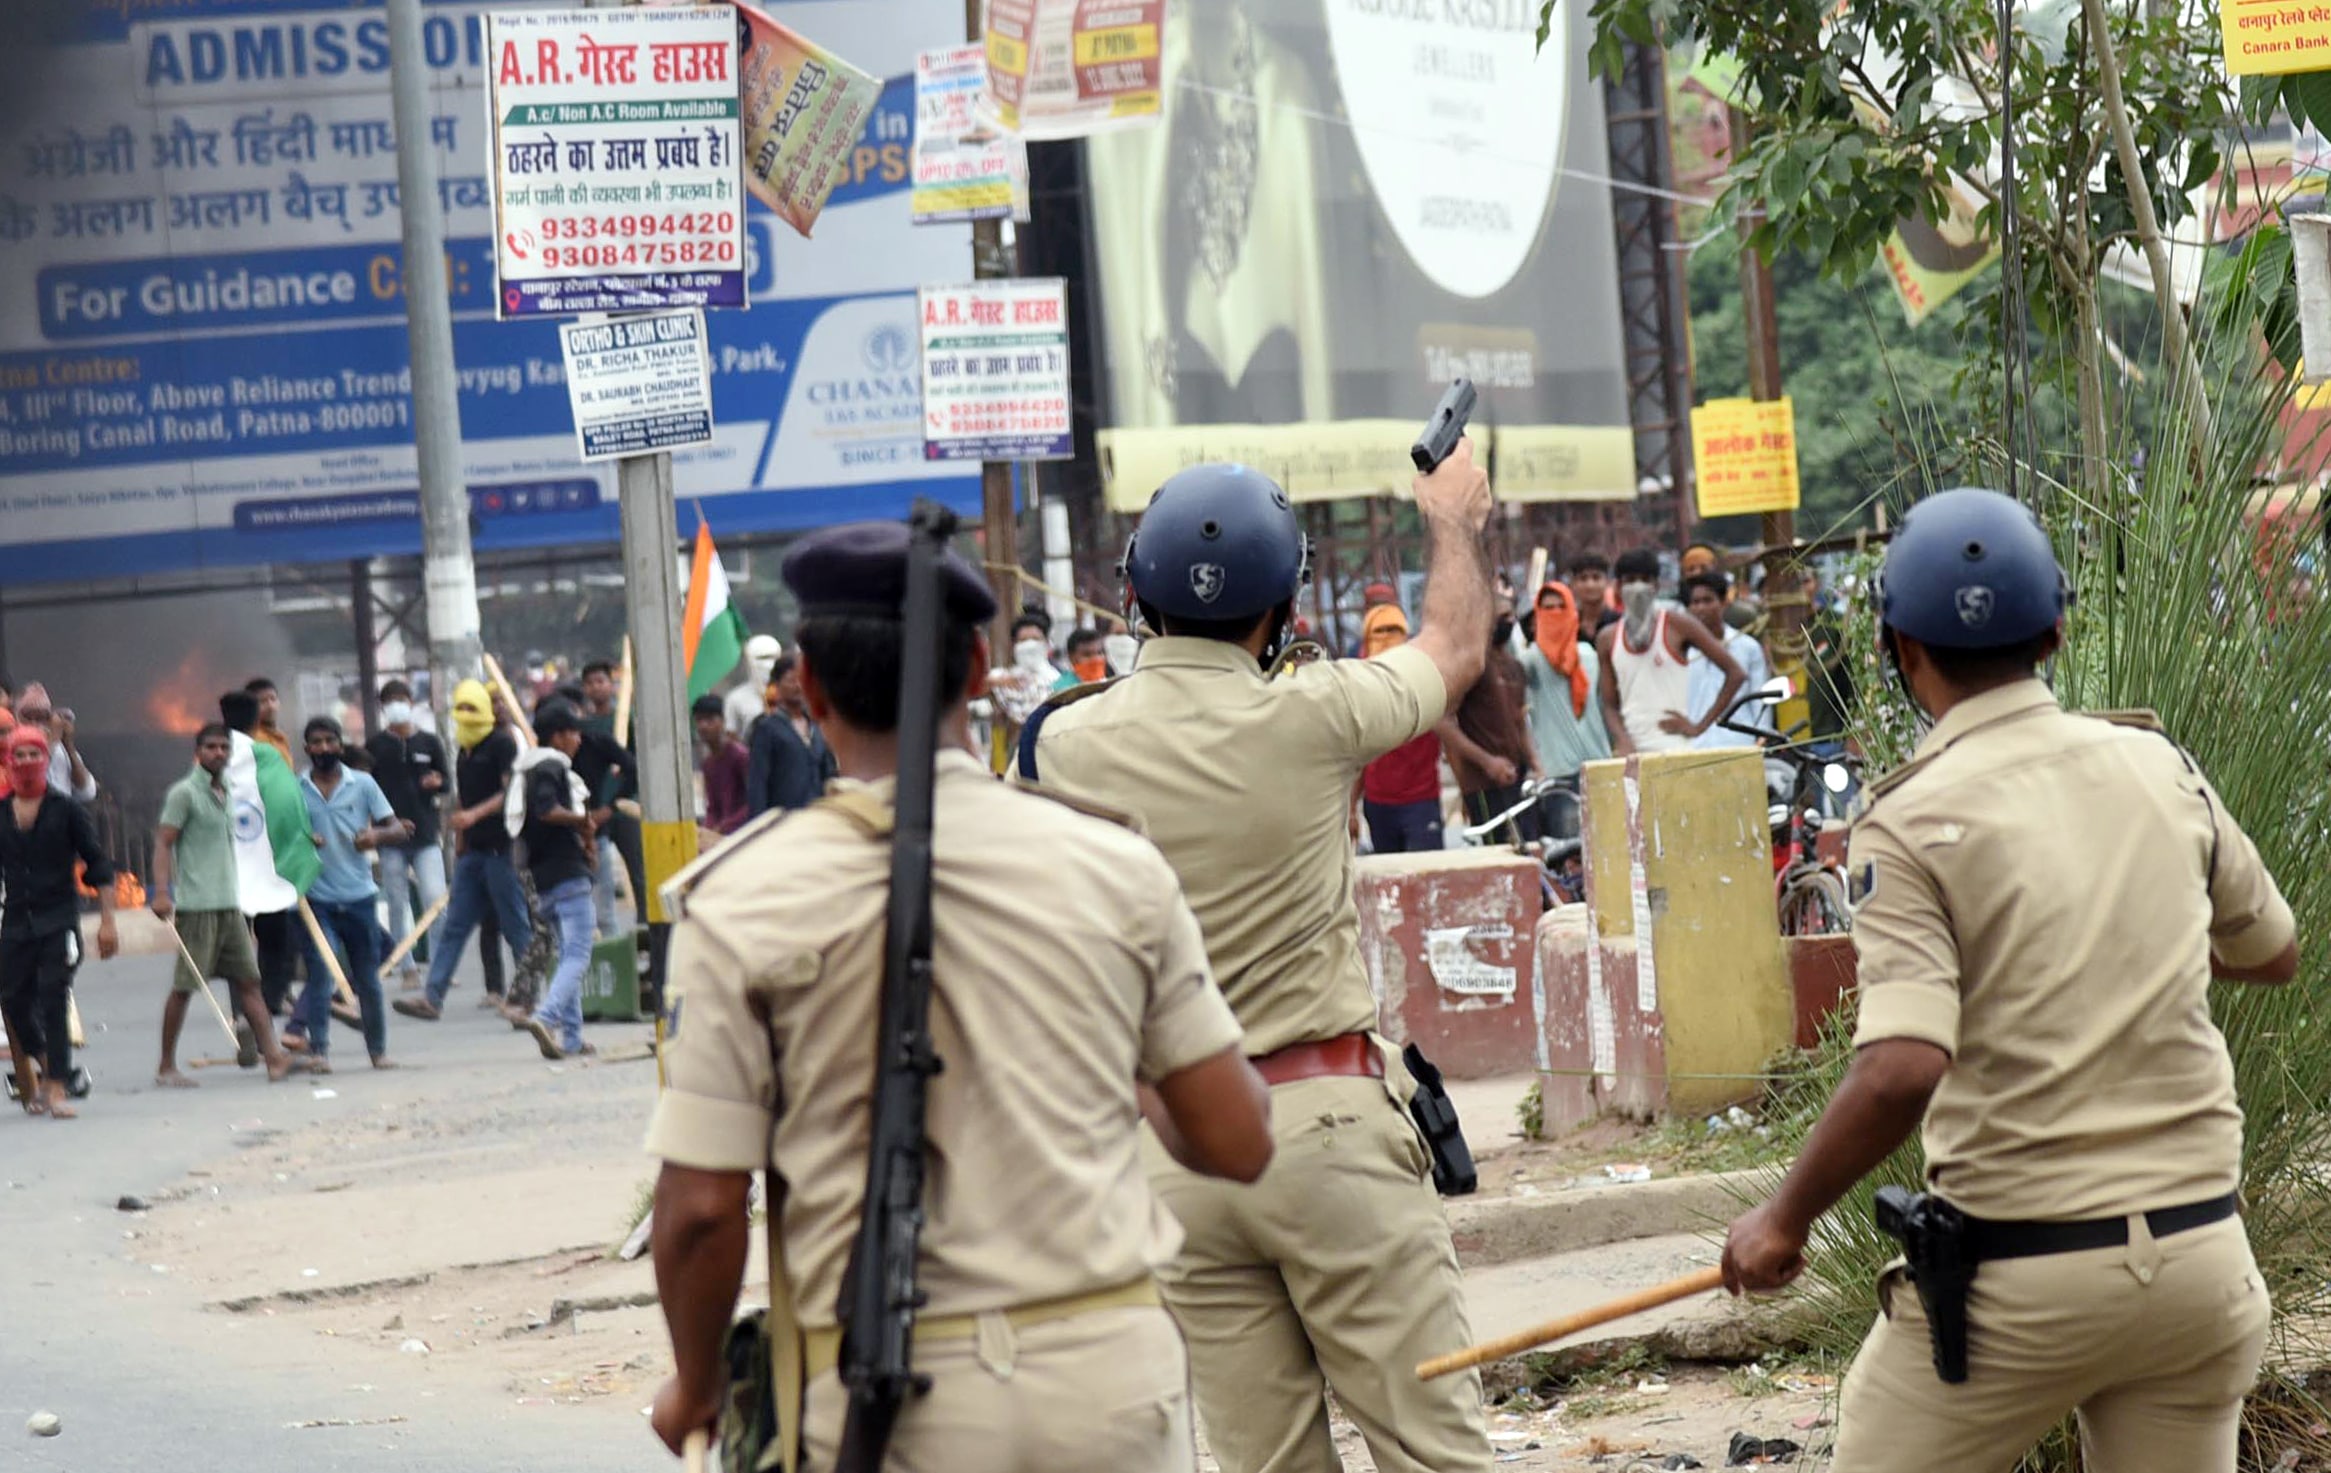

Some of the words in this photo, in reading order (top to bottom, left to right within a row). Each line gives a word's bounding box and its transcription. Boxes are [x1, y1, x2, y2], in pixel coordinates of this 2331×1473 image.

[145, 15, 484, 86] ADMISSO
[576, 33, 639, 85] गेस्ट
[649, 42, 729, 83] हाउस
[2243, 40, 2291, 54] Canara
[2295, 35, 2329, 50] Bank
[559, 107, 587, 121] Non
[591, 106, 615, 120] A.C
[618, 104, 659, 119] Room
[662, 101, 727, 118] Available
[876, 107, 908, 139] in
[151, 114, 219, 168] और
[506, 132, 558, 174] ठहरने
[566, 139, 594, 171] का
[51, 197, 155, 239] अलग
[170, 187, 270, 230] अलग
[505, 186, 531, 206] गर्म
[535, 182, 565, 205] पानी
[569, 181, 588, 204] की
[592, 184, 641, 203] व्यवस्था
[645, 180, 662, 201] भी
[541, 211, 735, 241] 9334994420
[542, 240, 735, 269] 9308475820
[55, 279, 129, 322] For
[139, 266, 356, 316] Guidance
[570, 325, 614, 355] ORTHO
[614, 325, 626, 348] &
[626, 318, 657, 345] SKIN
[656, 314, 695, 341] CLINIC
[601, 353, 640, 369] RICHA
[645, 343, 697, 362] THAKUR
[73, 388, 144, 417] Floor,
[151, 382, 225, 411] Above
[232, 374, 337, 405] Reliance
[341, 366, 412, 395] Trend
[807, 374, 923, 407] CHANA
[86, 415, 156, 450] Canal
[162, 410, 232, 444] Road,
[238, 401, 408, 437] Patna-800001
